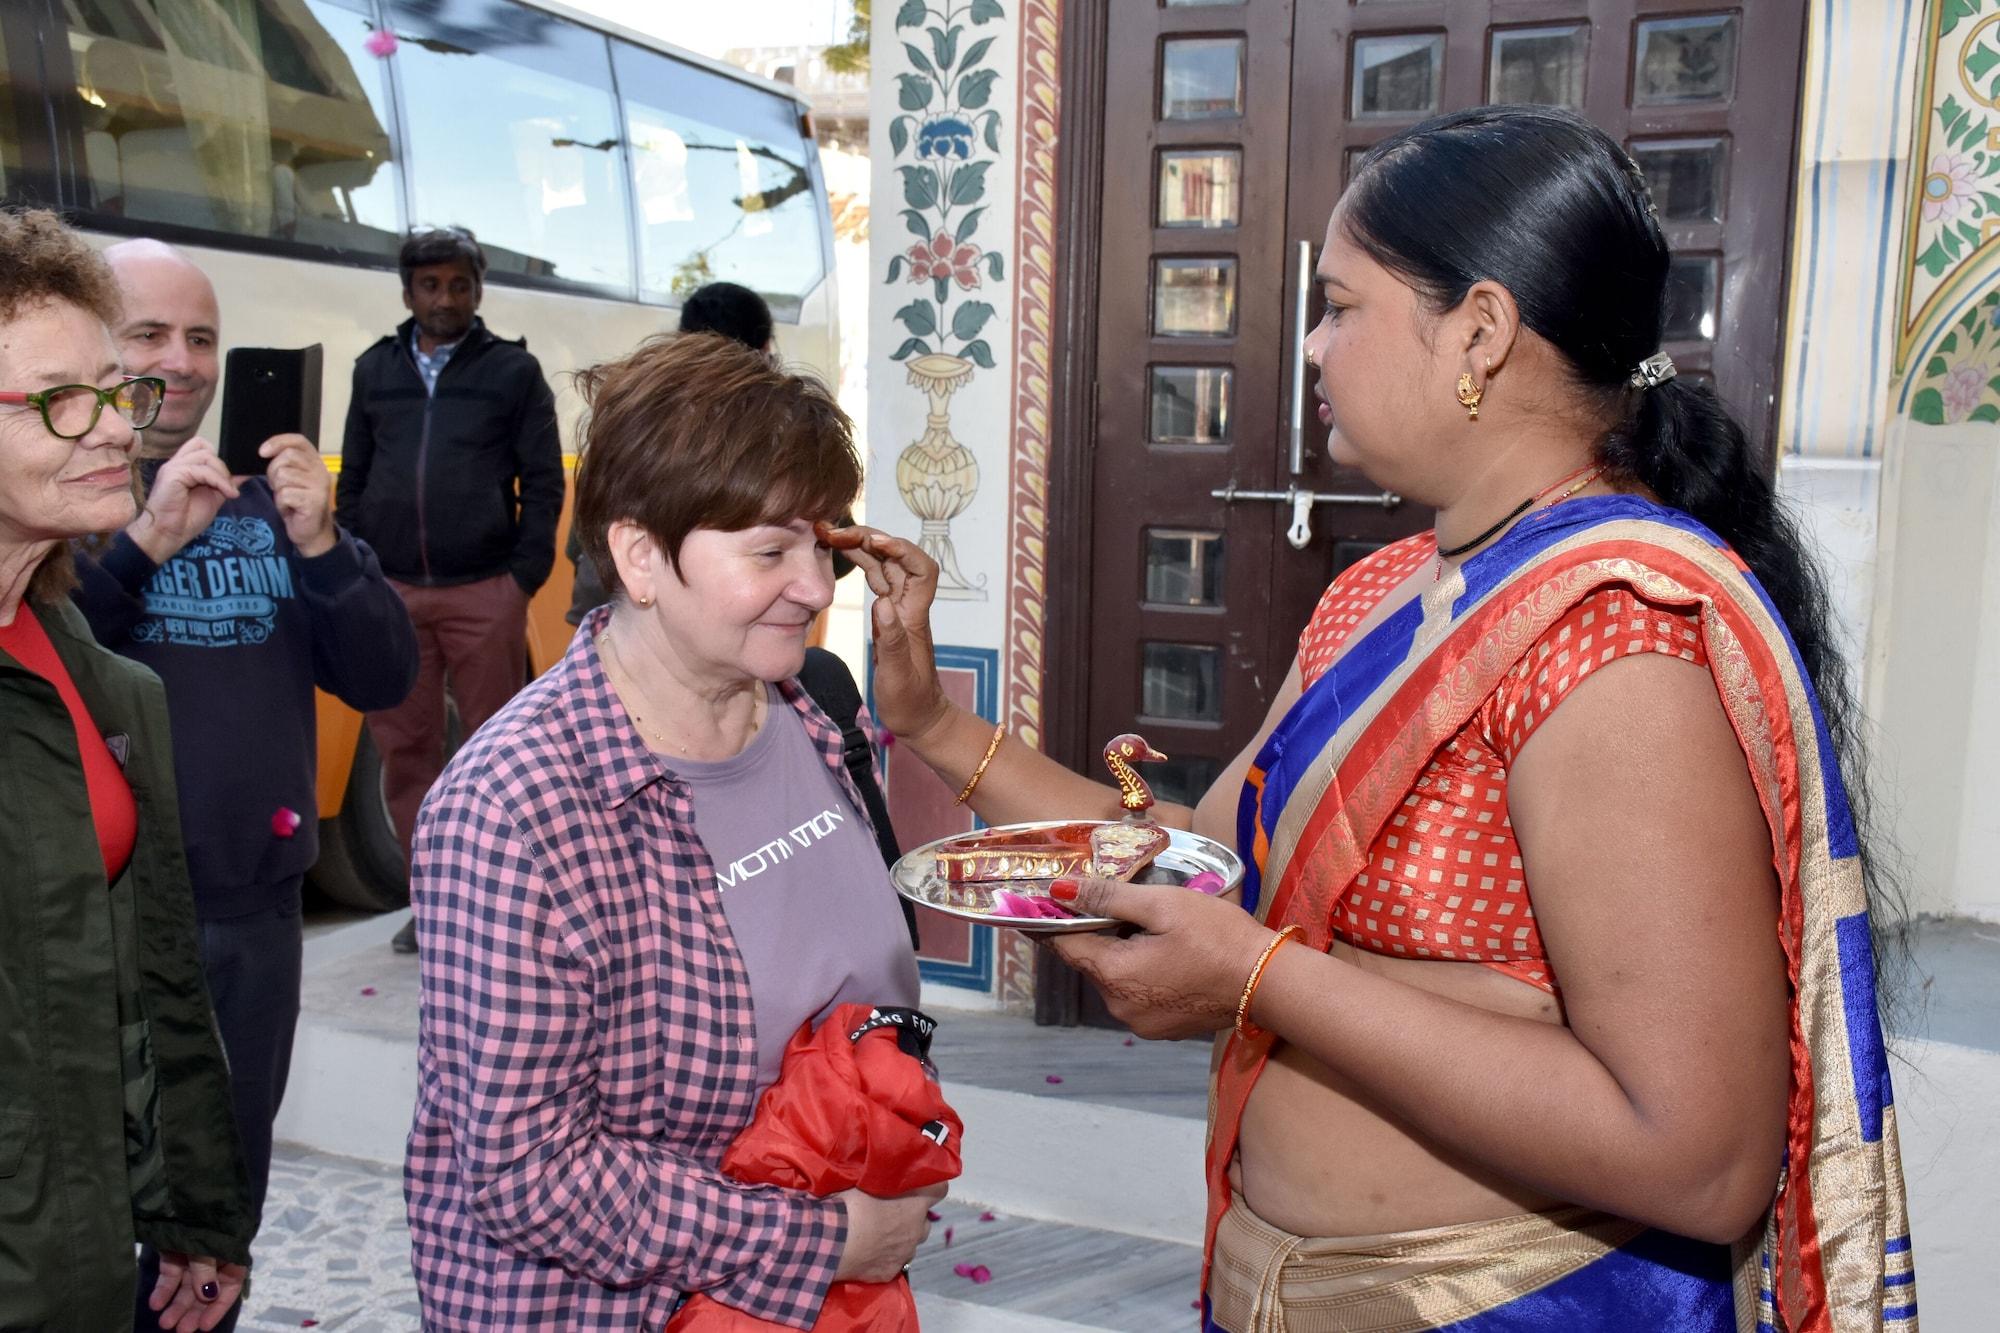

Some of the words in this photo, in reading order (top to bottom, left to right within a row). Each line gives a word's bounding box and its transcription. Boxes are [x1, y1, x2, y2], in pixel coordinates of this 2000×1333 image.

[151, 559, 203, 599] IGER
[205, 556, 294, 599] DENIM
[213, 619, 235, 637] CITY
[851, 1014, 904, 1040] OVING
